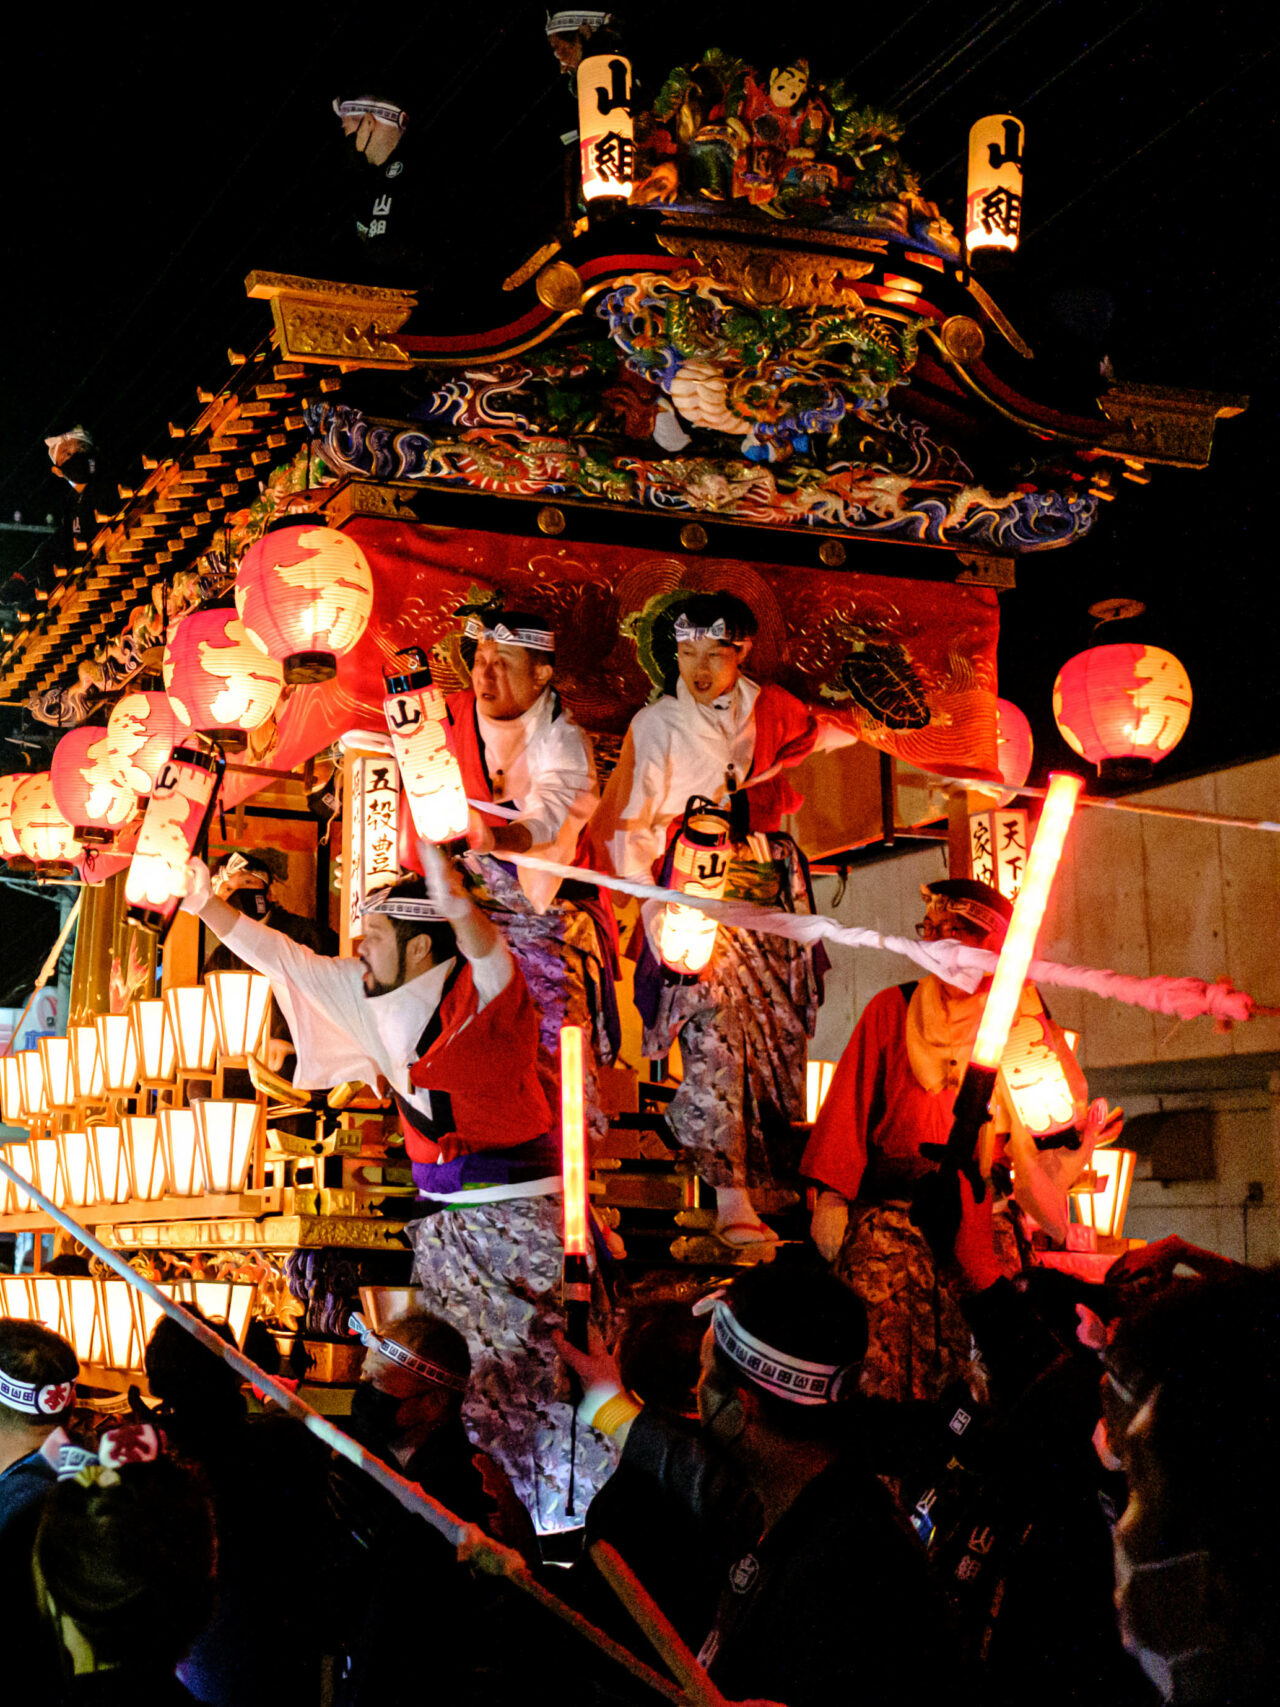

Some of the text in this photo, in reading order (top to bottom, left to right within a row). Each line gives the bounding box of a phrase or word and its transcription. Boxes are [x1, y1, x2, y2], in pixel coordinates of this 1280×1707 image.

[595, 59, 633, 183] 山組
[982, 119, 1023, 237] 山組
[390, 699, 421, 728] 山
[155, 765, 178, 790] 山
[366, 767, 399, 875] 五穀豊
[1000, 820, 1026, 900] 天下
[697, 853, 726, 880] 山
